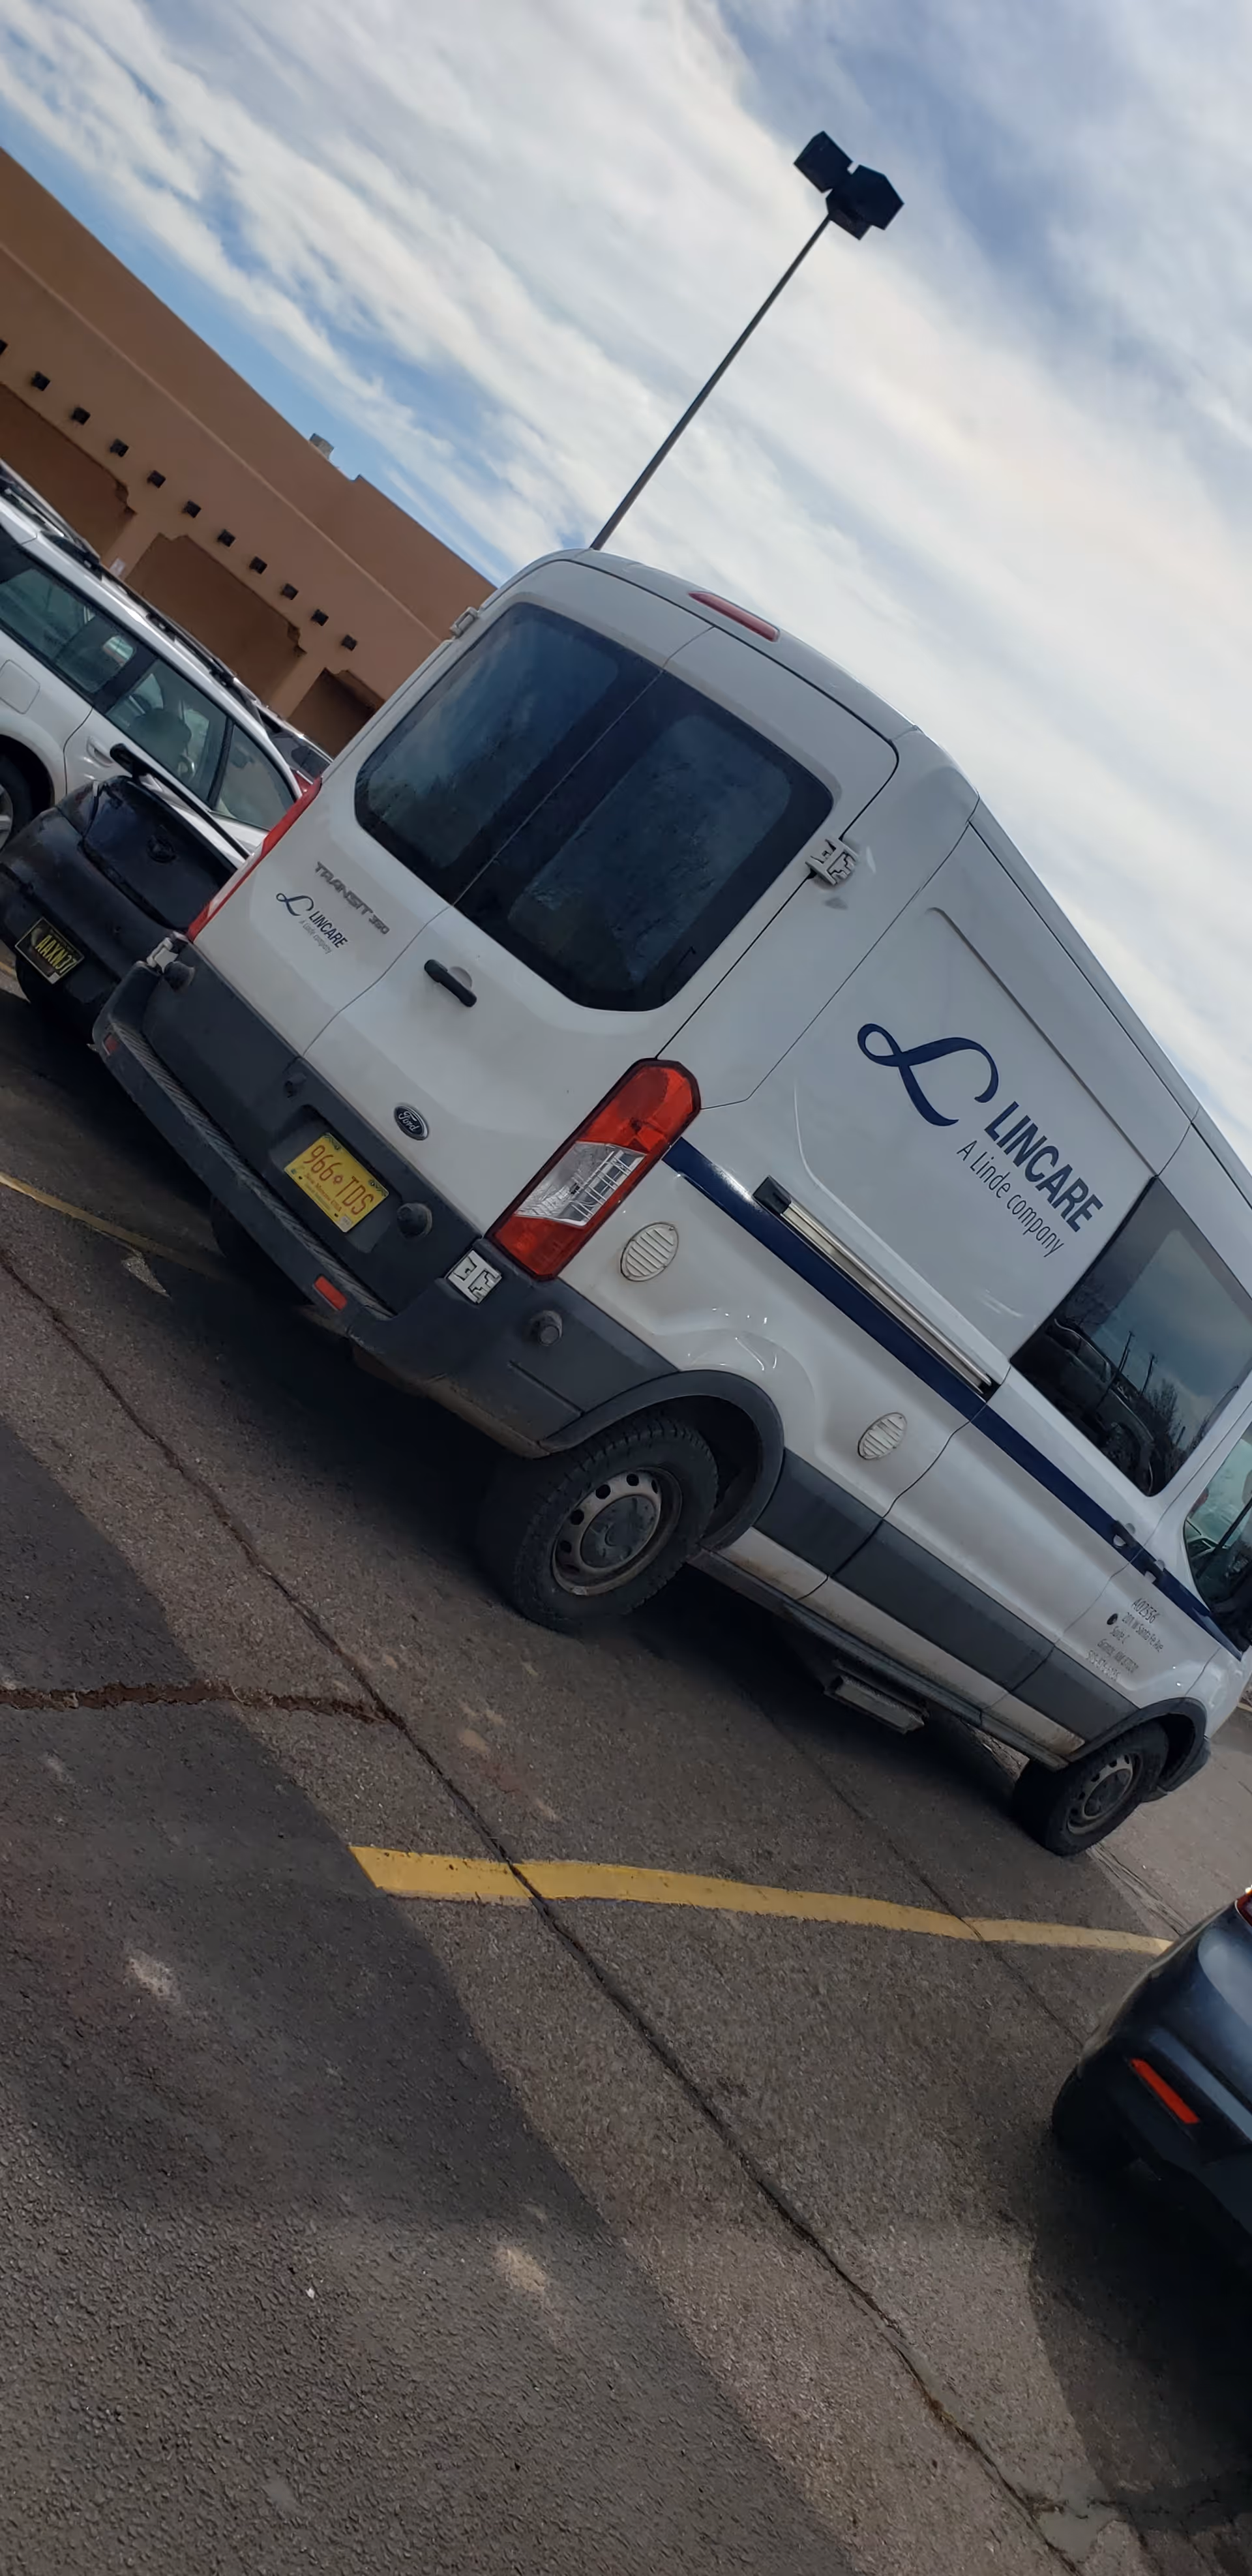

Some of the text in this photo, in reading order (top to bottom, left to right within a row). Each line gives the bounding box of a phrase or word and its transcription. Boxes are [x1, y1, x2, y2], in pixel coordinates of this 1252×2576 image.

[316, 861, 373, 915] TRANSIT
[308, 910, 348, 948] LINCARE
[35, 935, 77, 973] AAXN37
[398, 1111, 421, 1132] Ford
[984, 1101, 1103, 1233] LINCARE
[956, 1140, 1064, 1257] A Linde company
